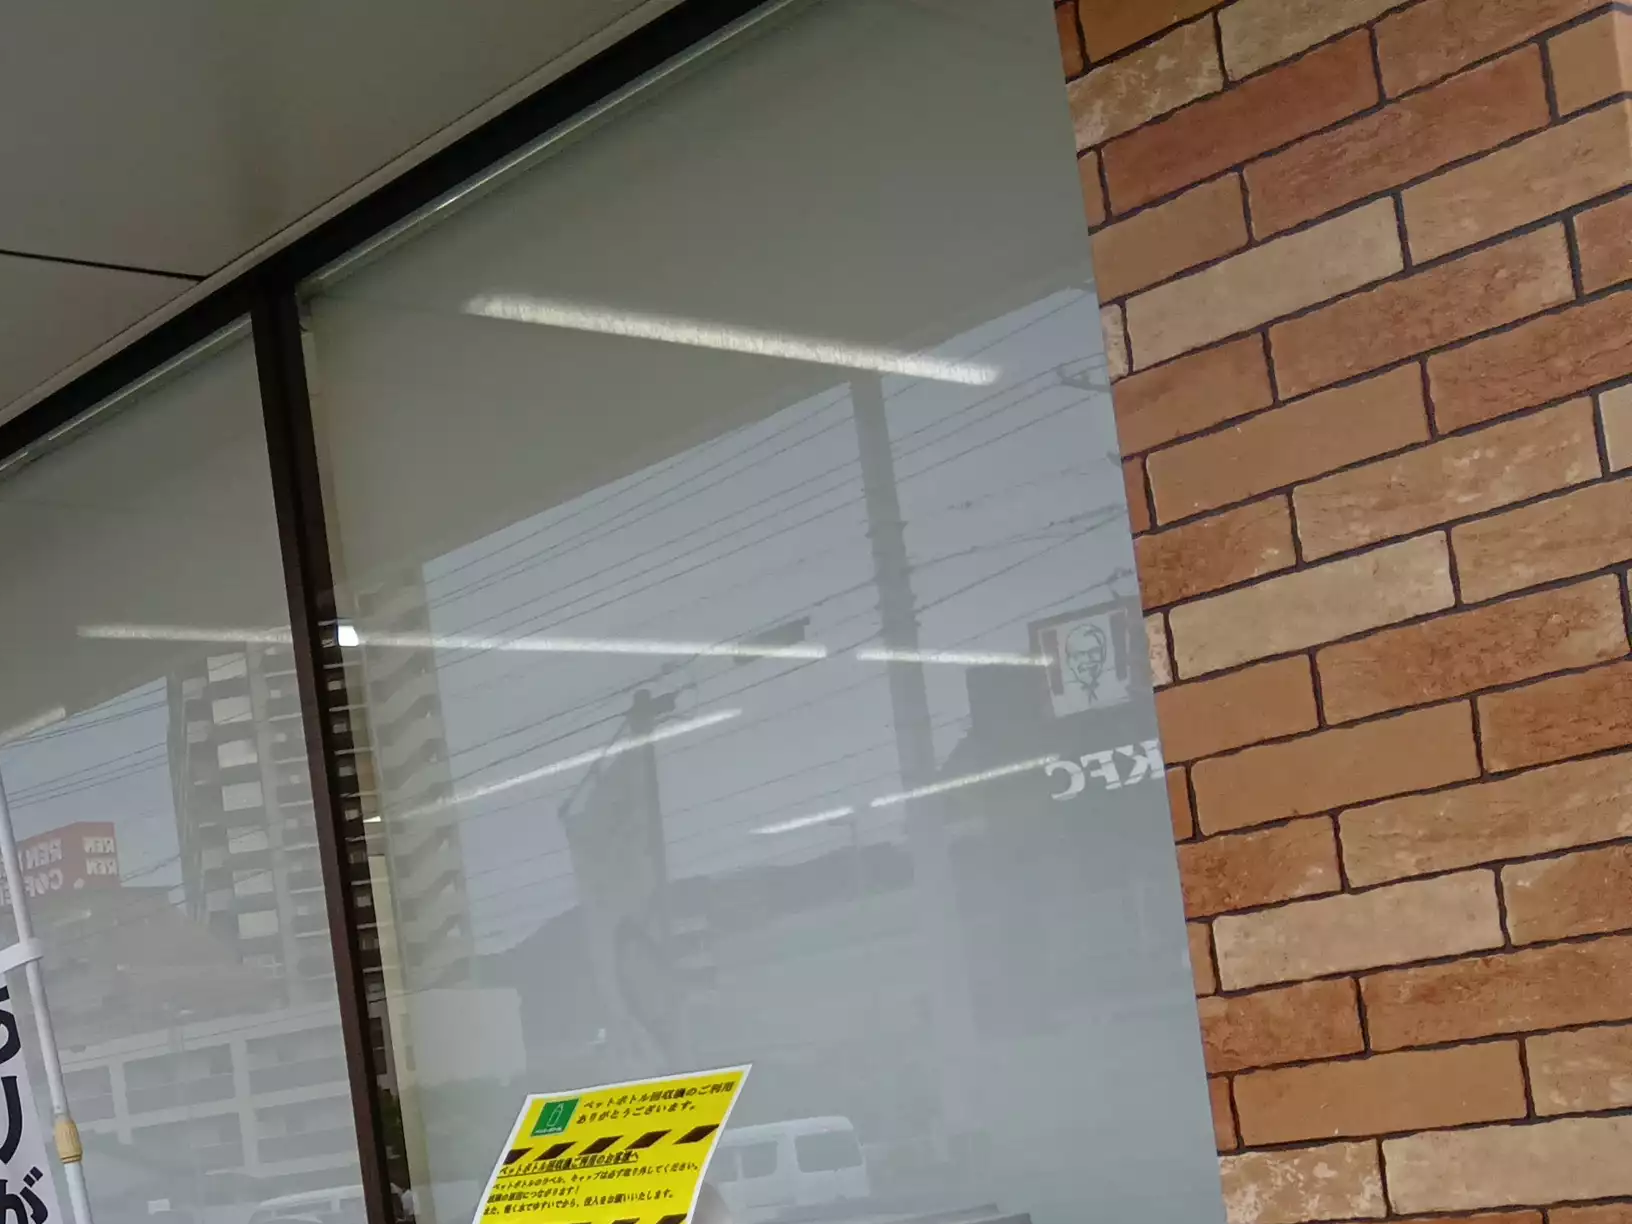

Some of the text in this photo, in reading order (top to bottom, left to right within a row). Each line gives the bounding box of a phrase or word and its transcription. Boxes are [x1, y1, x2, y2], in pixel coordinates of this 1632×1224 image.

[575, 1100, 698, 1125] ありがとうございます。
